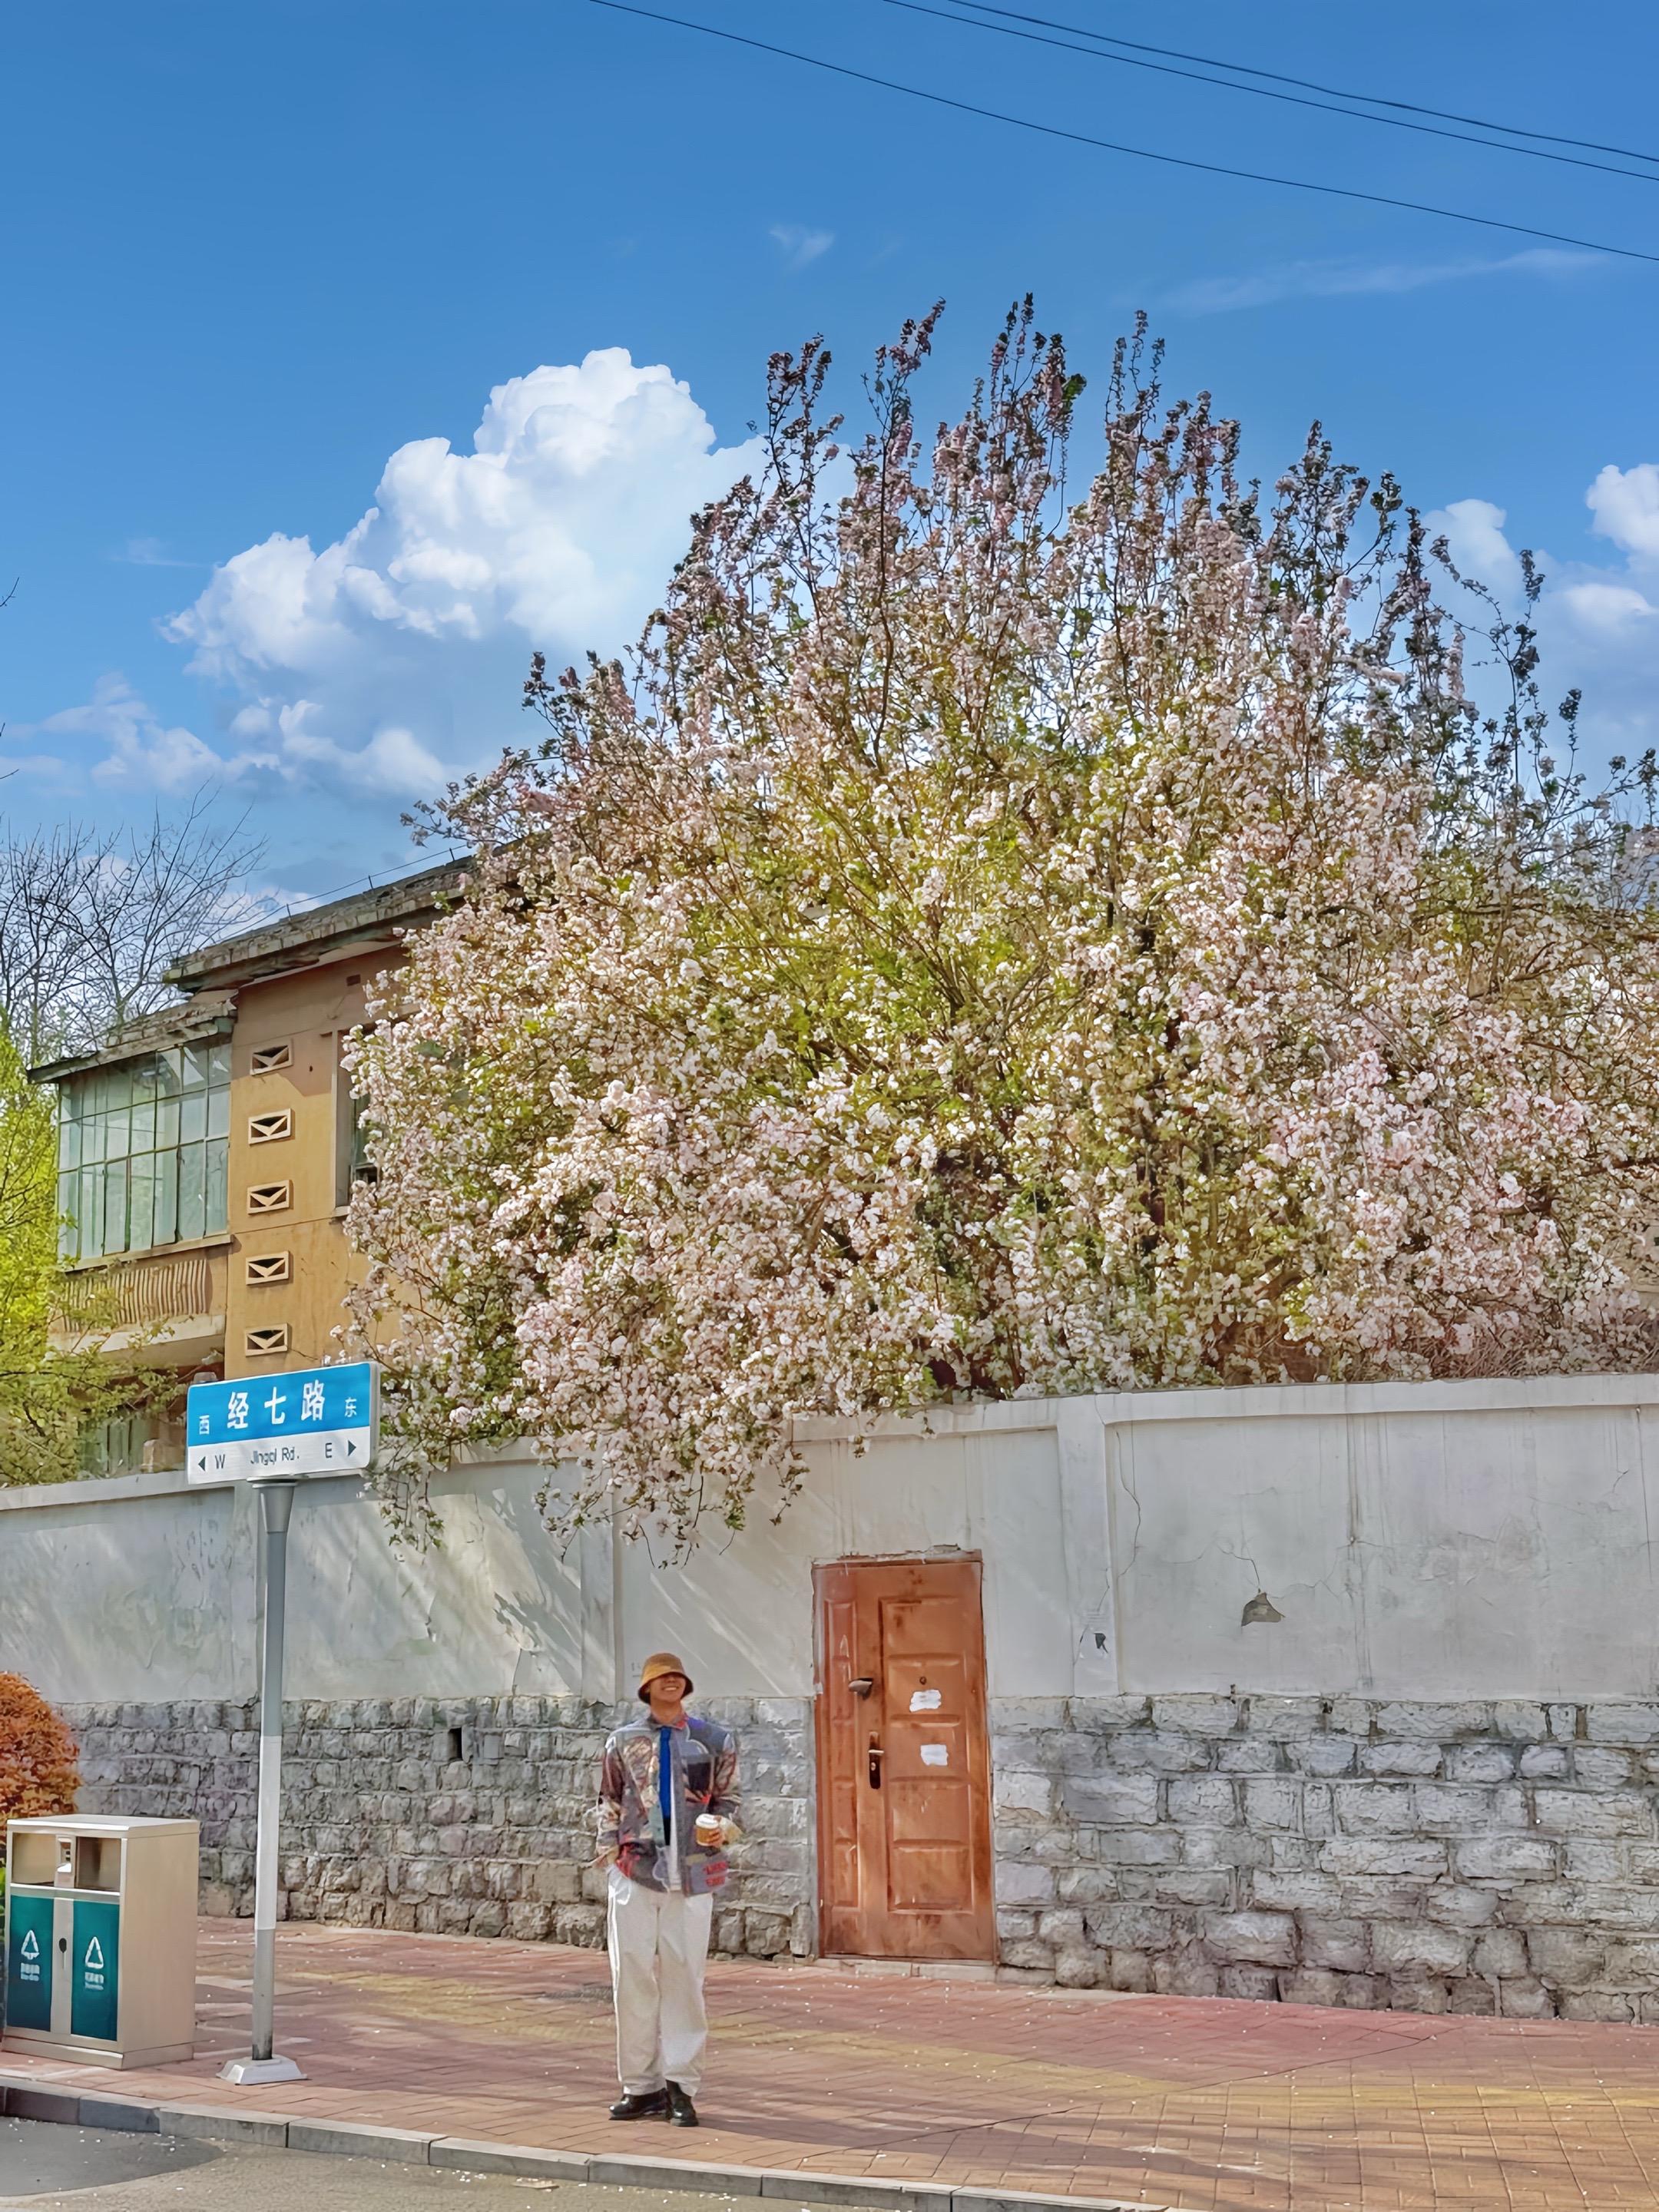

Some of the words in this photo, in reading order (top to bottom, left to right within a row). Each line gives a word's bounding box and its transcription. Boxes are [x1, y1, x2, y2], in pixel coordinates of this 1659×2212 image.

[227, 1379, 325, 1429] 经七路
[344, 1397, 357, 1418] 东
[198, 1415, 210, 1435] 西
[325, 1442, 333, 1459] E
[215, 1454, 226, 1469] W
